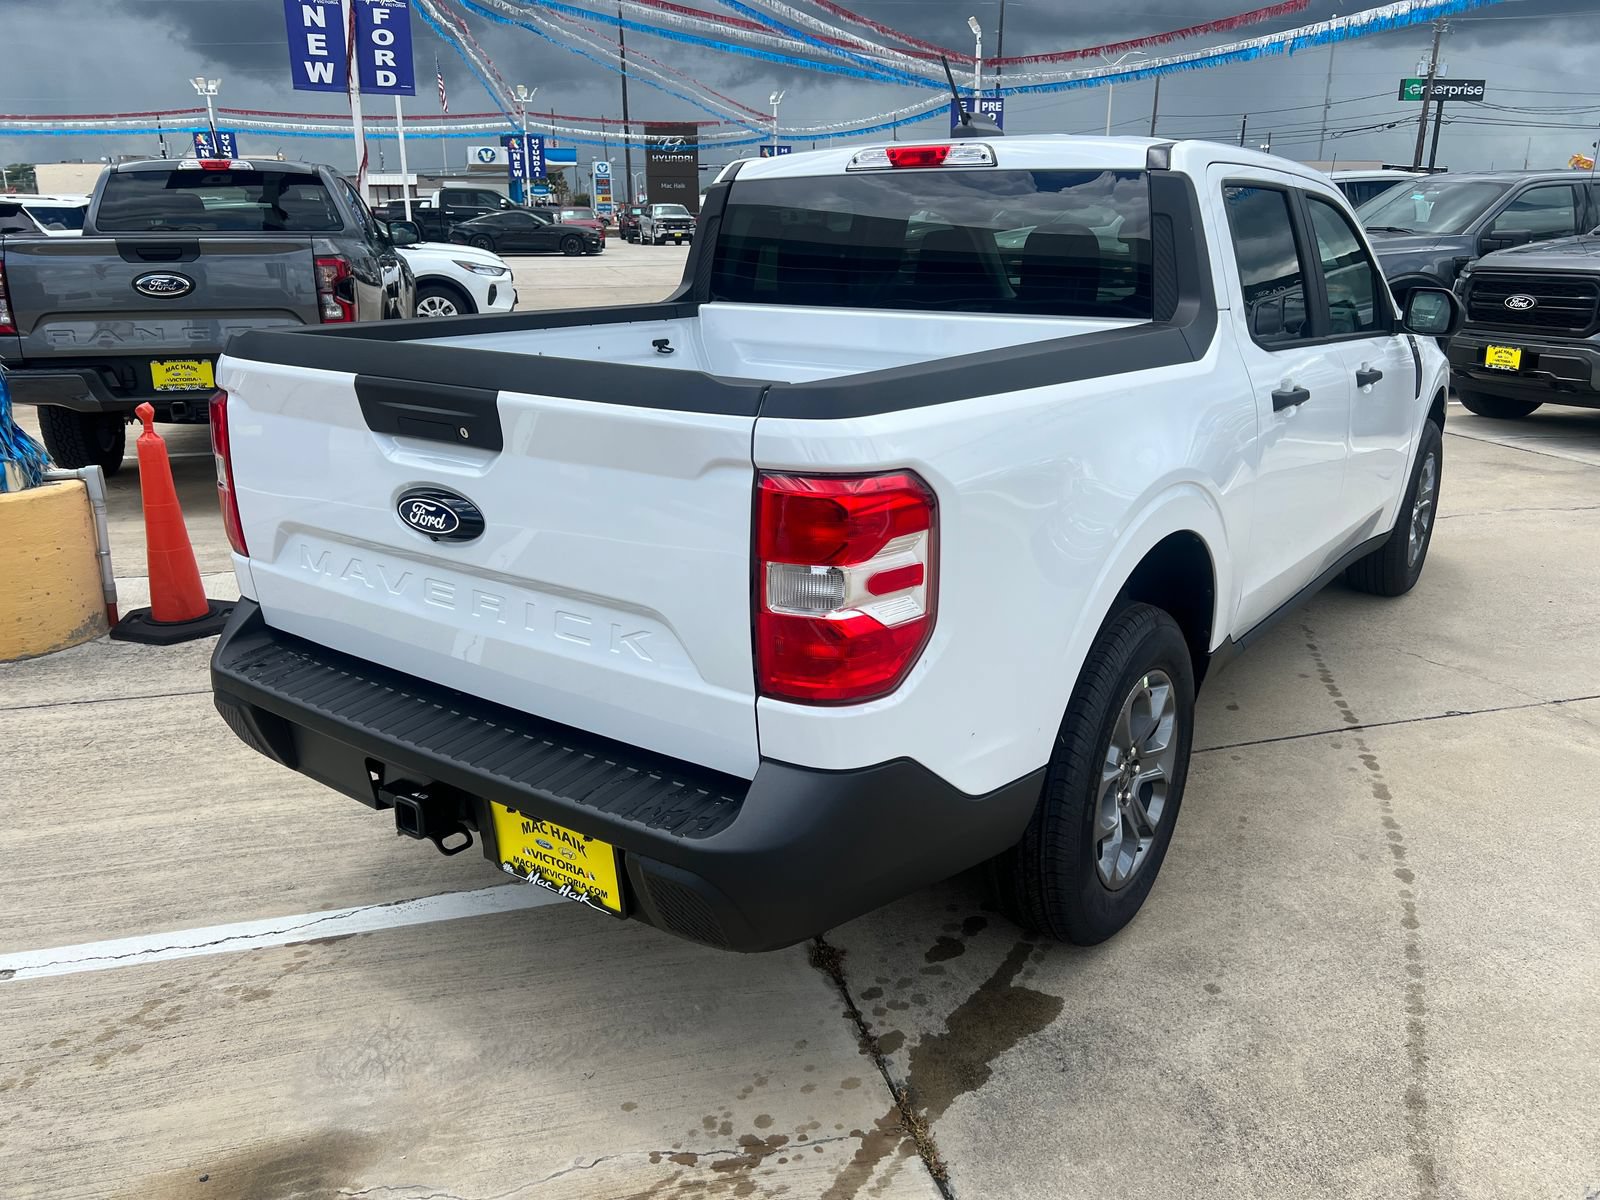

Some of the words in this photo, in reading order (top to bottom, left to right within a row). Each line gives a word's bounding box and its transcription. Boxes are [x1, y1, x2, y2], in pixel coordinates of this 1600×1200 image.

[301, 4, 335, 85] NEW
[371, 8, 398, 87] FORD
[981, 101, 1003, 112] PRE
[220, 133, 233, 159] HYUN
[531, 138, 542, 178] HYUNDAI
[651, 154, 695, 163] HYUNDAI
[512, 152, 523, 178] NEW
[148, 278, 177, 291] Ford
[1509, 297, 1530, 308] Ford
[46, 327, 253, 345] RANG
[165, 364, 180, 373] MAC
[408, 502, 447, 530] Ford
[299, 543, 655, 662] MAVERICK
[521, 820, 549, 835] MAC
[549, 825, 588, 859] HAIK
[531, 848, 586, 879] VICTORIA
[525, 870, 557, 892] Mac
